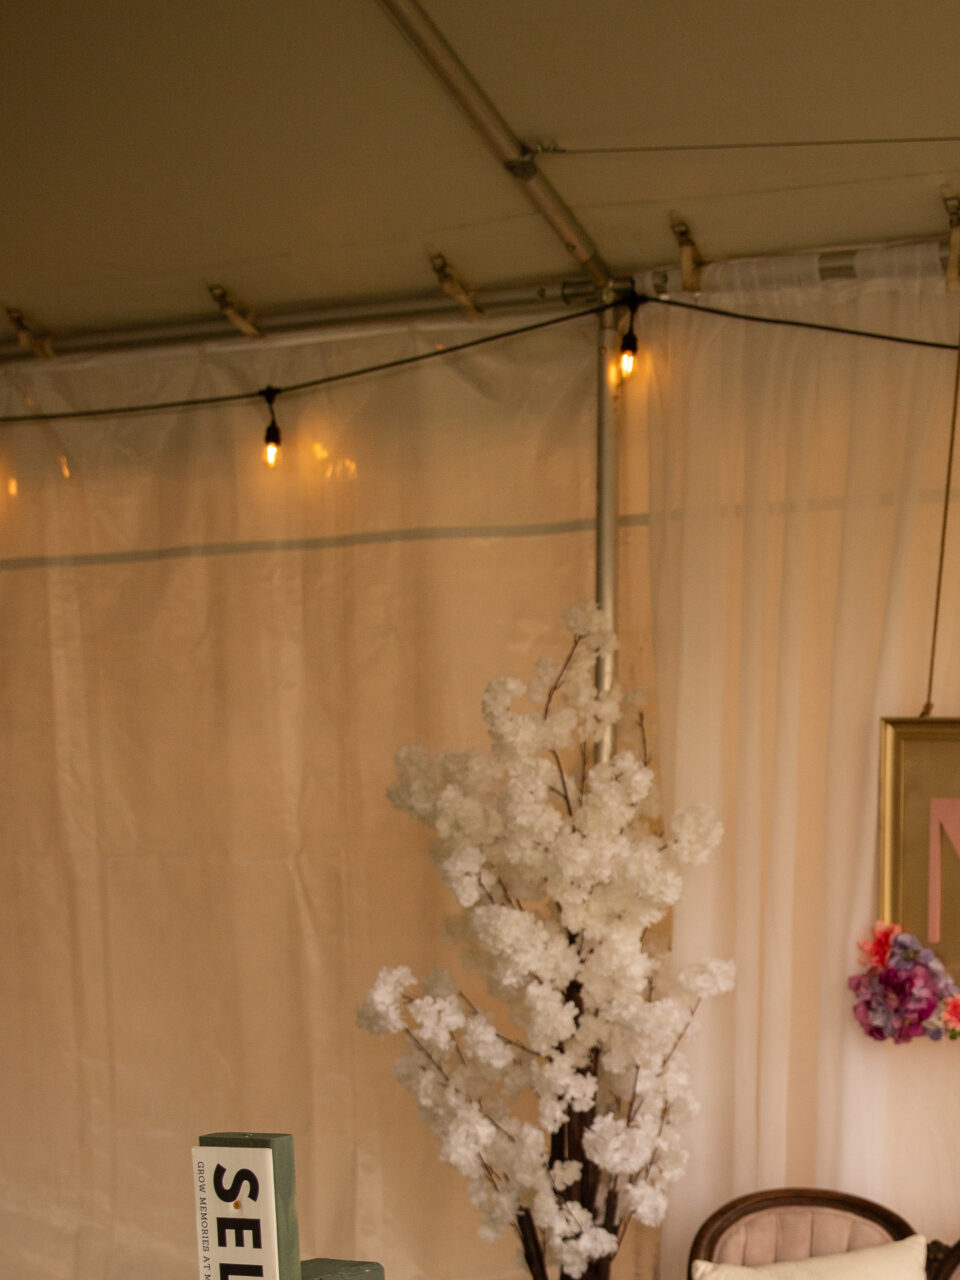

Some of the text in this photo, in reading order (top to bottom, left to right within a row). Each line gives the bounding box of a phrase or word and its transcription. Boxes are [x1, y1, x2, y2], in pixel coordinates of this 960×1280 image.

[197, 1161, 206, 1193] GROW
[199, 1197, 210, 1252] MEMORIES
[203, 1256, 211, 1270] AT
